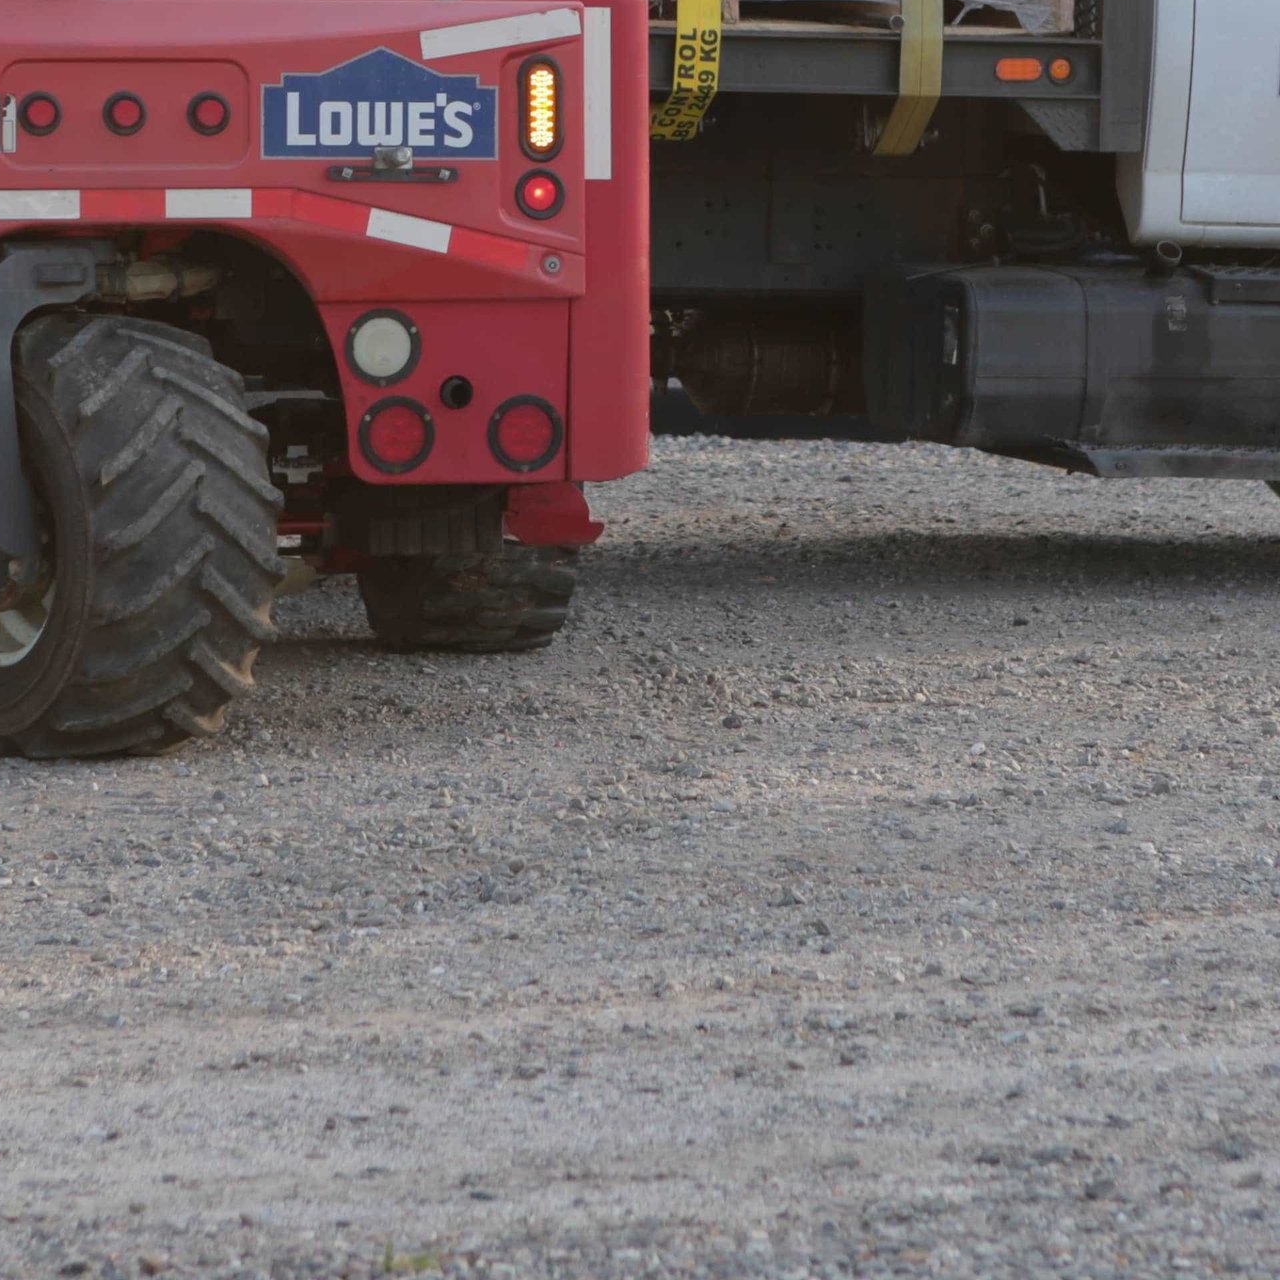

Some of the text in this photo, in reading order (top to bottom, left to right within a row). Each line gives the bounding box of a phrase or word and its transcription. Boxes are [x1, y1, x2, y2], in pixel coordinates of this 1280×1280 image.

[700, 28, 718, 62] KG
[658, 27, 697, 128] CONTROL
[286, 91, 473, 149] LOWE'S
